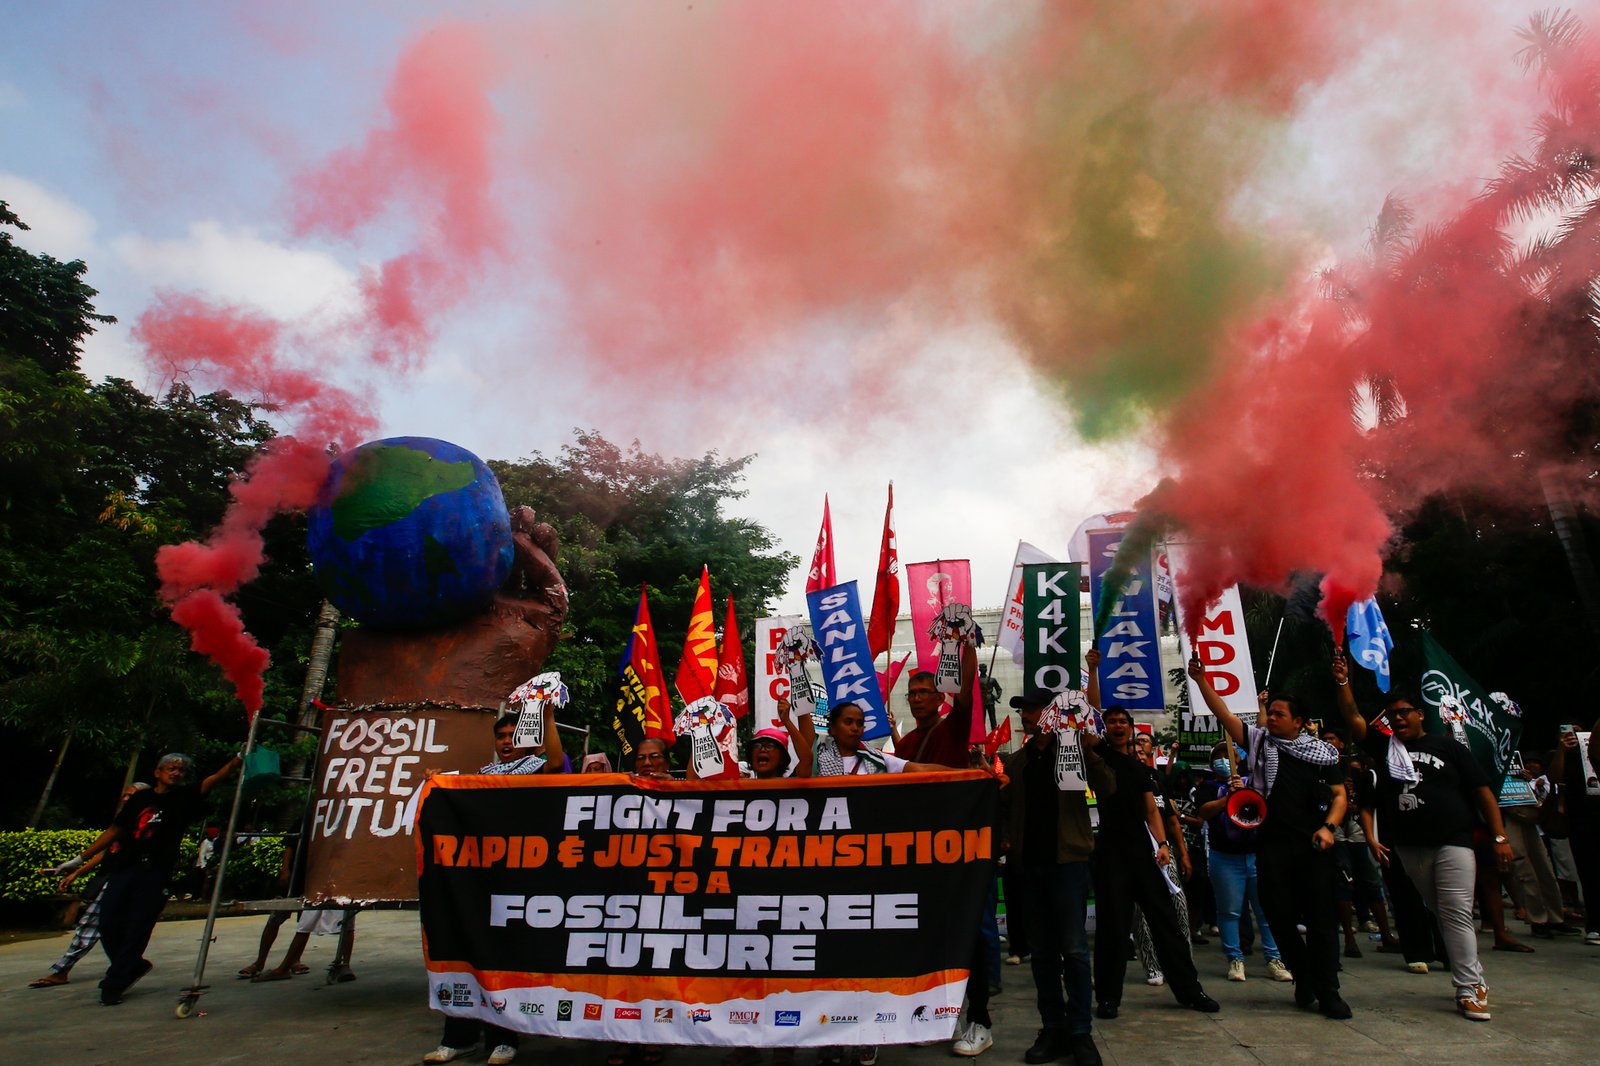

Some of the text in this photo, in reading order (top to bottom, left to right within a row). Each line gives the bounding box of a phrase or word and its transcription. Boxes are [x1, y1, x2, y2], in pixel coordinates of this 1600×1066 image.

[1197, 610, 1240, 697] MDD
[941, 661, 959, 669] THEM
[792, 675, 805, 684] TAKE
[792, 682, 809, 692] THEM
[1182, 712, 1218, 732] TAX
[324, 718, 449, 755] FOSSIL
[695, 735, 711, 745] TAKE
[695, 742, 716, 753] THEM
[1060, 745, 1077, 753] TAKE
[1060, 754, 1080, 762] THEM
[322, 756, 420, 796] FREE
[312, 798, 412, 841] FUTU
[563, 794, 852, 832] FIGHT FOR A
[433, 826, 992, 868] RAPID & JUST TRANSITION
[647, 871, 732, 894] TO A
[490, 893, 919, 930] FOSSIL-FREE
[566, 932, 817, 971] FUTURE
[694, 1010, 710, 1018] PLM
